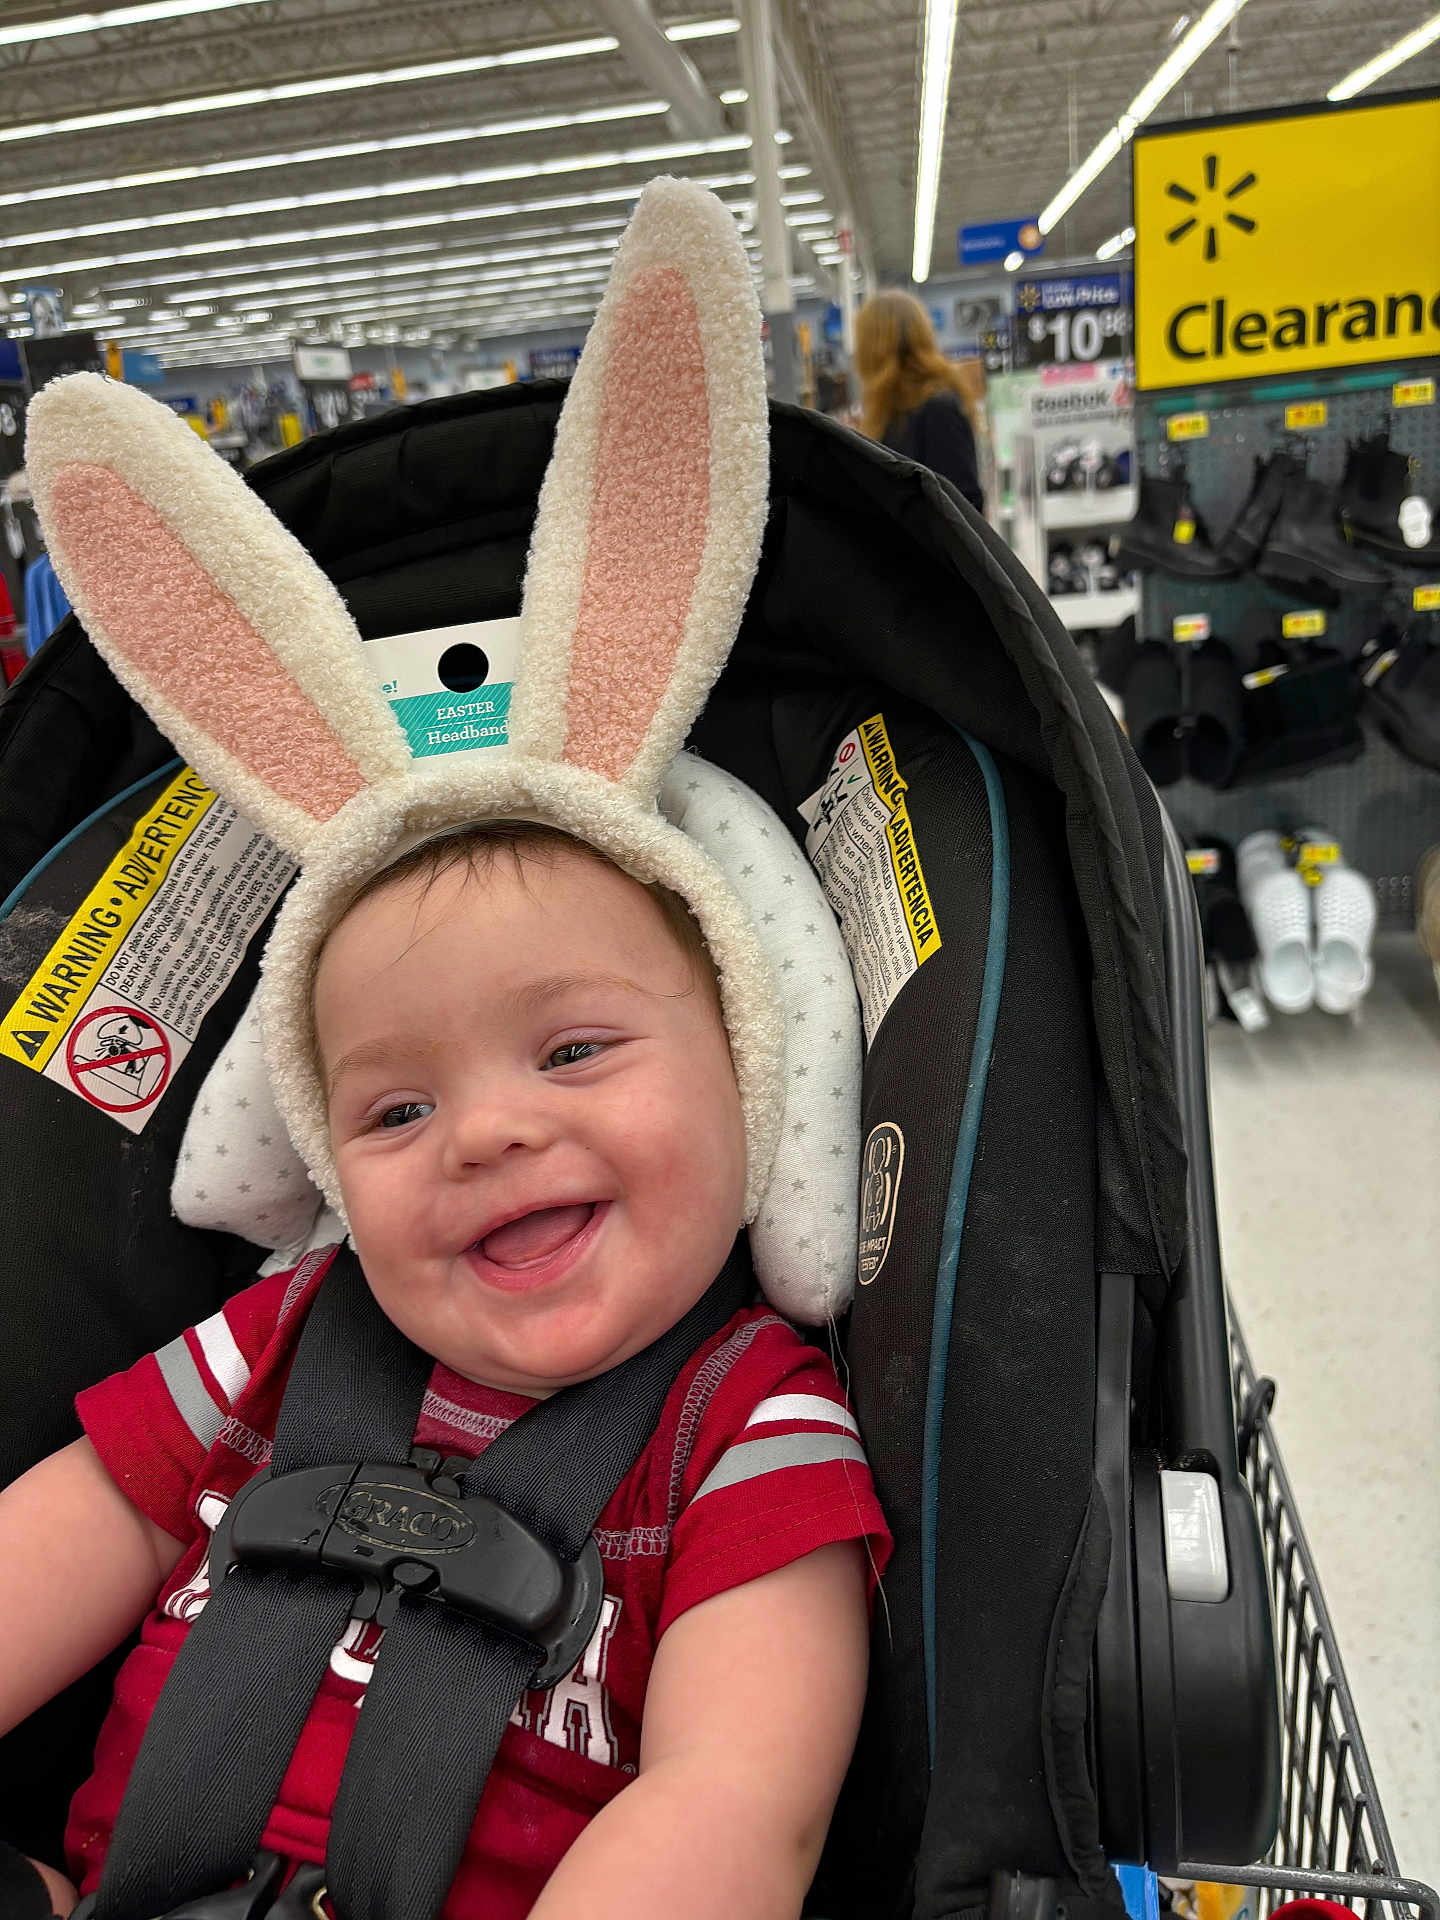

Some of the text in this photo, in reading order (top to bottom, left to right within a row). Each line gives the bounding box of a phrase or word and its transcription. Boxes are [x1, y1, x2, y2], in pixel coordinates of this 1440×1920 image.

[436, 700, 496, 721] EASTER
[202, 811, 221, 832] seat
[214, 815, 235, 839] back
[188, 826, 210, 850] front
[204, 833, 222, 852] The
[850, 829, 873, 856] when
[864, 729, 934, 948] WARNING ADVERTENCIA
[183, 846, 197, 860] on
[188, 847, 212, 877] occur.
[874, 837, 893, 890] TRANGLED
[178, 872, 196, 892] can
[196, 861, 220, 890] under.
[231, 877, 250, 897] con
[25, 771, 212, 1023] WARNING ADVERTENC
[186, 886, 205, 907] and
[264, 881, 278, 895] 12
[146, 995, 163, 1013] NO
[169, 954, 184, 970] un
[235, 828, 265, 865] orientad
[179, 902, 195, 919] 12
[141, 911, 175, 954] SERIOUS
[134, 947, 151, 965] OR
[156, 938, 173, 956] for
[113, 950, 133, 972] NOT
[105, 968, 123, 987] DO
[117, 960, 144, 994] DEATH
[129, 971, 155, 1002] safest
[342, 1490, 462, 1544] GRACO
